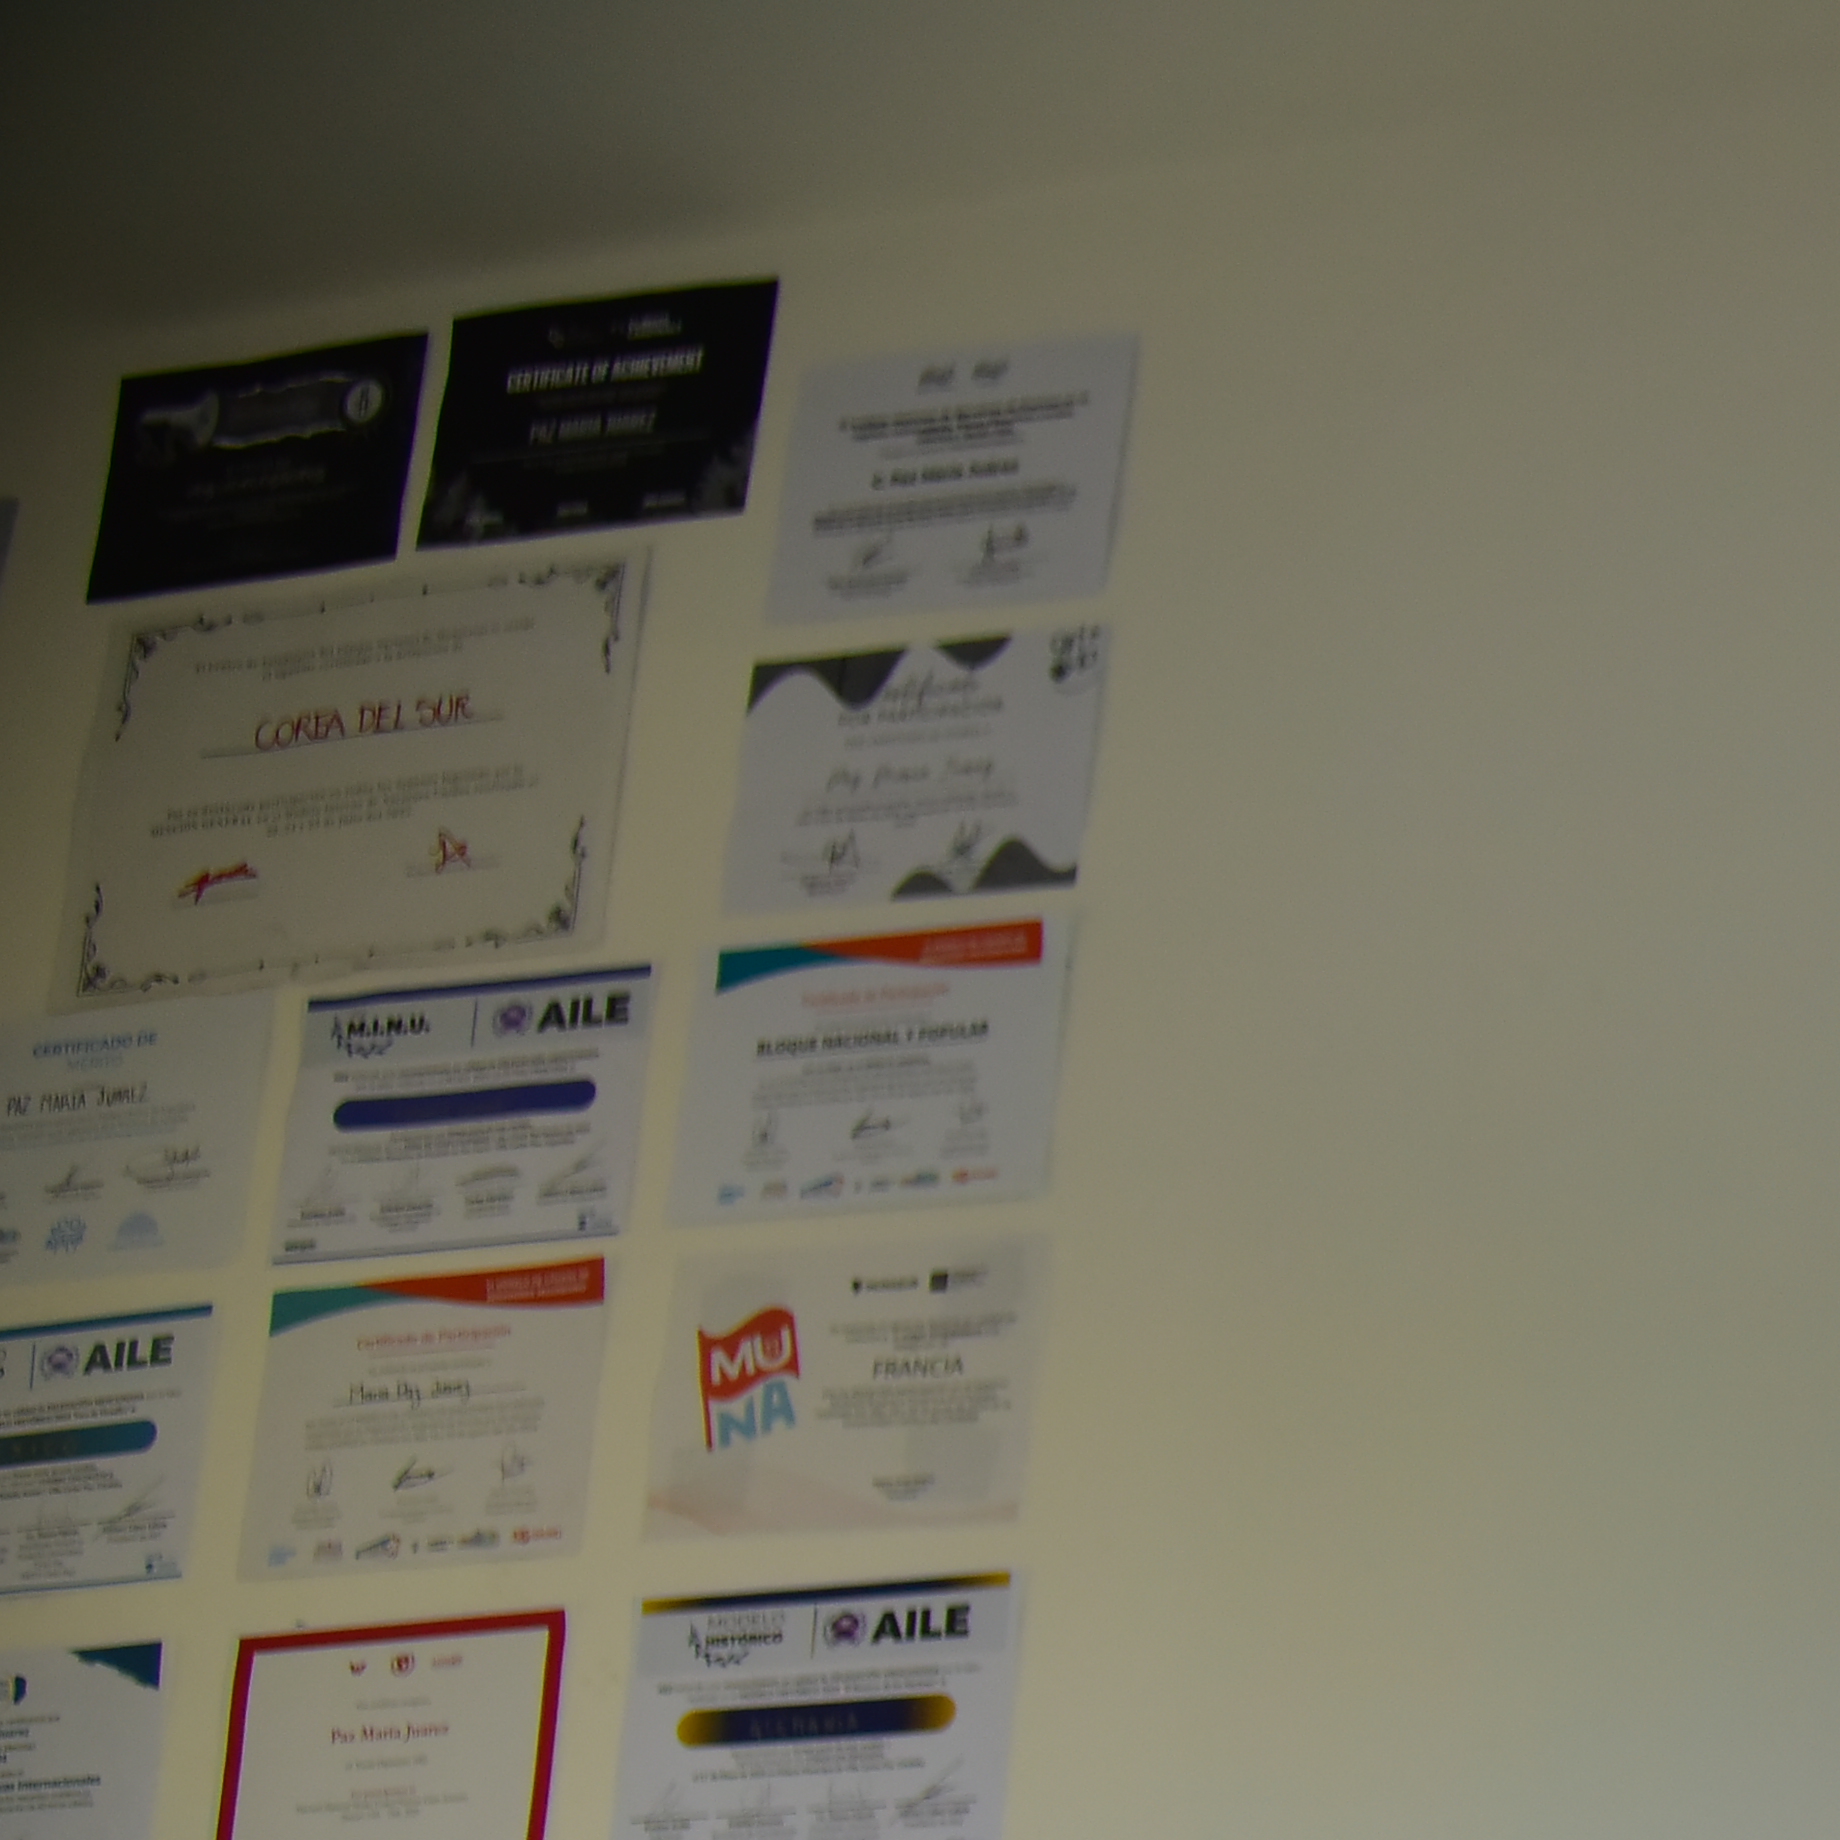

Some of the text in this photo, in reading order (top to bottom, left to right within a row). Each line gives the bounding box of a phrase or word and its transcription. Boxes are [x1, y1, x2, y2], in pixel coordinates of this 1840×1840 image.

[507, 344, 704, 395] CERTIFICATE OF ACHIEVEMENT
[254, 689, 474, 751] COREA DEL SUR
[346, 1011, 430, 1039] M.I.N.U.
[537, 990, 632, 1034] AILE
[33, 1028, 158, 1059] CERTIFICADO DE
[83, 1335, 175, 1377] AILE
[709, 1326, 793, 1387] MU
[872, 1353, 965, 1379] FRANCIA
[716, 1380, 797, 1449] NA
[870, 1602, 972, 1646] AILE
